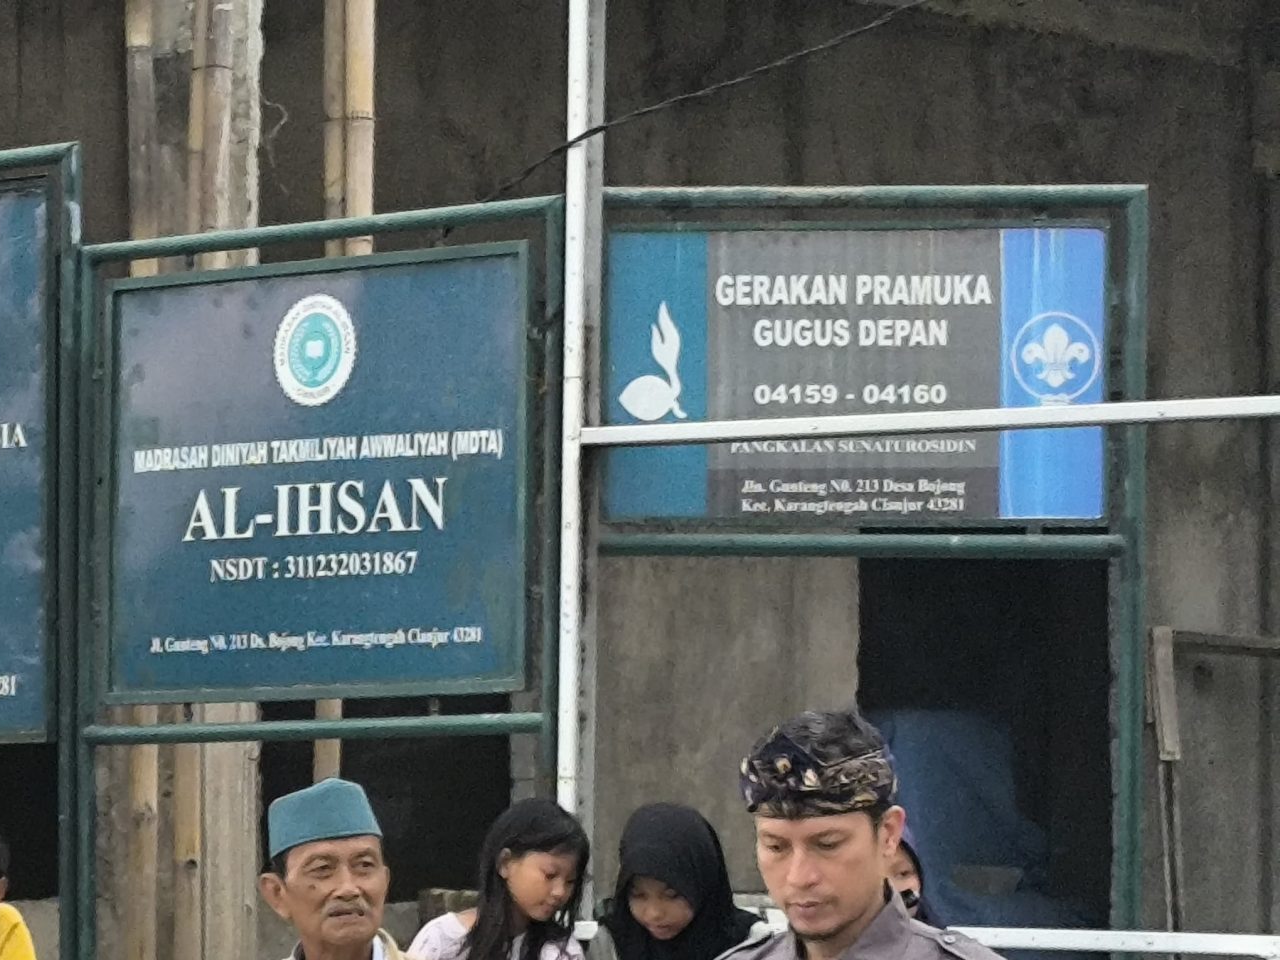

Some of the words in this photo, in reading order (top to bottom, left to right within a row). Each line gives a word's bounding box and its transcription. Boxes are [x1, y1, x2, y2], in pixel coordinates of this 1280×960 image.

[715, 274, 847, 306] GERAKAN
[855, 274, 992, 304] PRAMUKA
[754, 319, 849, 347] GUGUS
[859, 319, 948, 346] DEPAN
[754, 383, 838, 405] 04159
[863, 383, 947, 405] 04160
[133, 446, 208, 473] MADRASAH
[211, 441, 267, 467] DINIYAH
[271, 436, 357, 463] TAKMILIYAH
[360, 432, 448, 459] AWWALIYAH
[450, 429, 503, 461] (MDTA)
[730, 440, 835, 453] PANGKALAN
[855, 479, 879, 493] 213
[882, 479, 915, 493] Desa
[917, 478, 966, 495] Bojong
[182, 477, 448, 542] AL-IHSAN
[210, 557, 267, 583] NSDT
[284, 551, 418, 579] 311232031867
